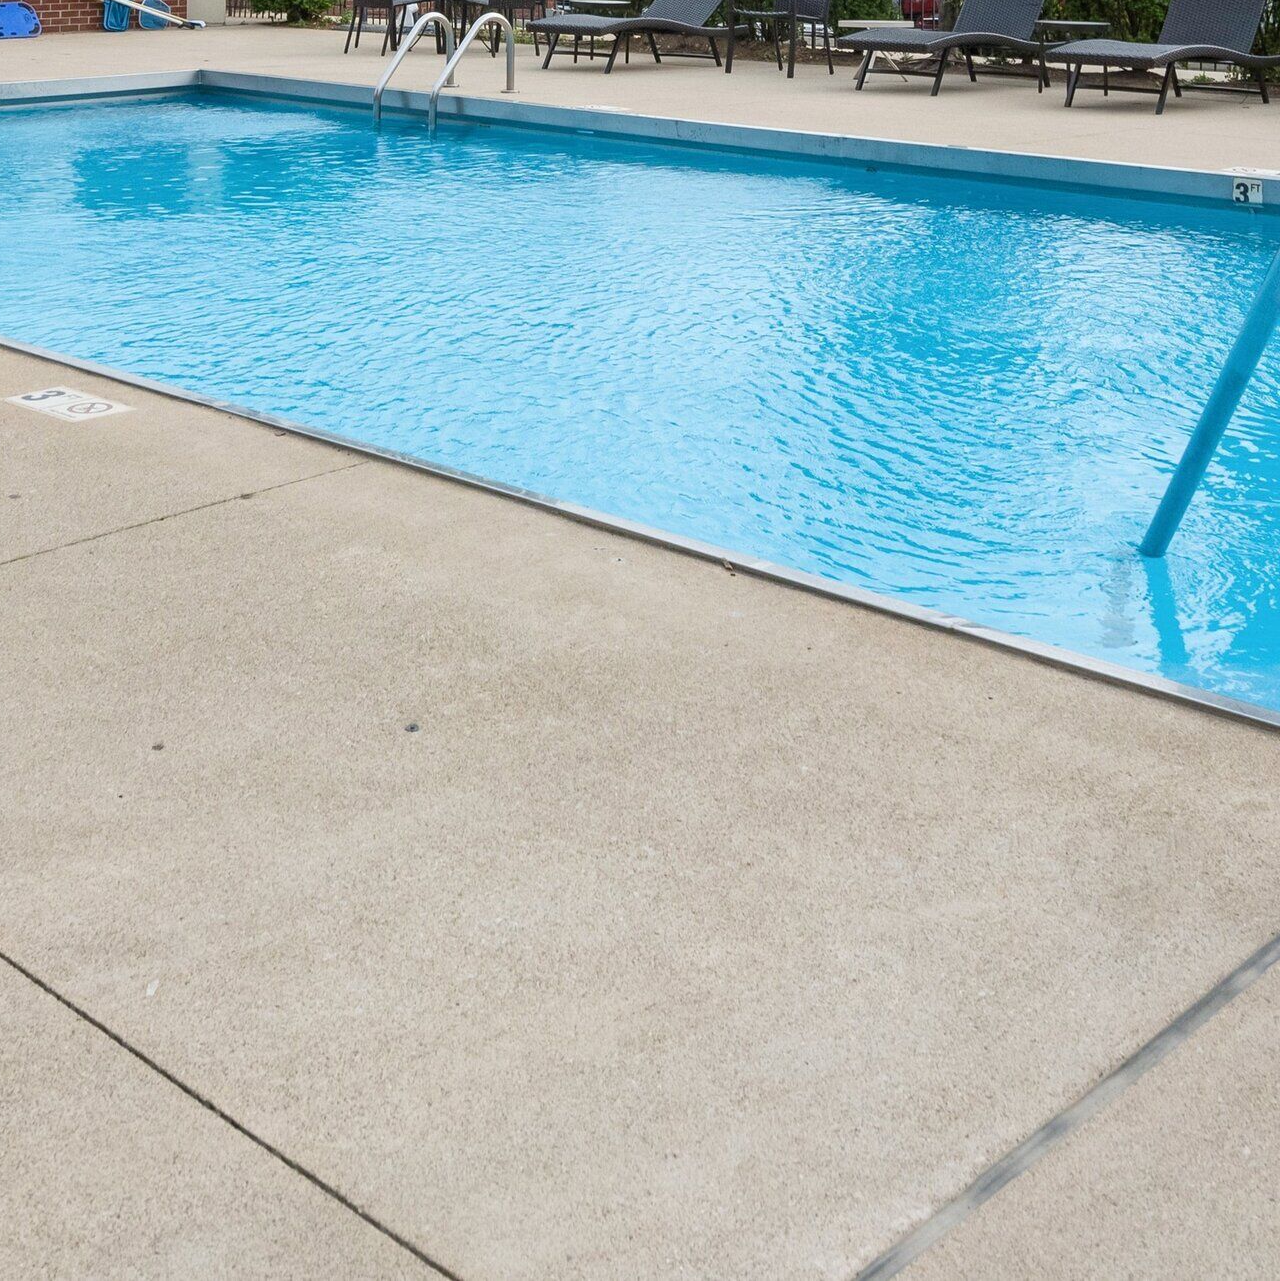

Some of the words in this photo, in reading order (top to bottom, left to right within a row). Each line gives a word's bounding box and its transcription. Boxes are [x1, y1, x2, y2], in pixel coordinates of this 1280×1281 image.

[1235, 182, 1250, 203] 3
[1250, 183, 1261, 193] FT
[21, 390, 66, 401] 3
